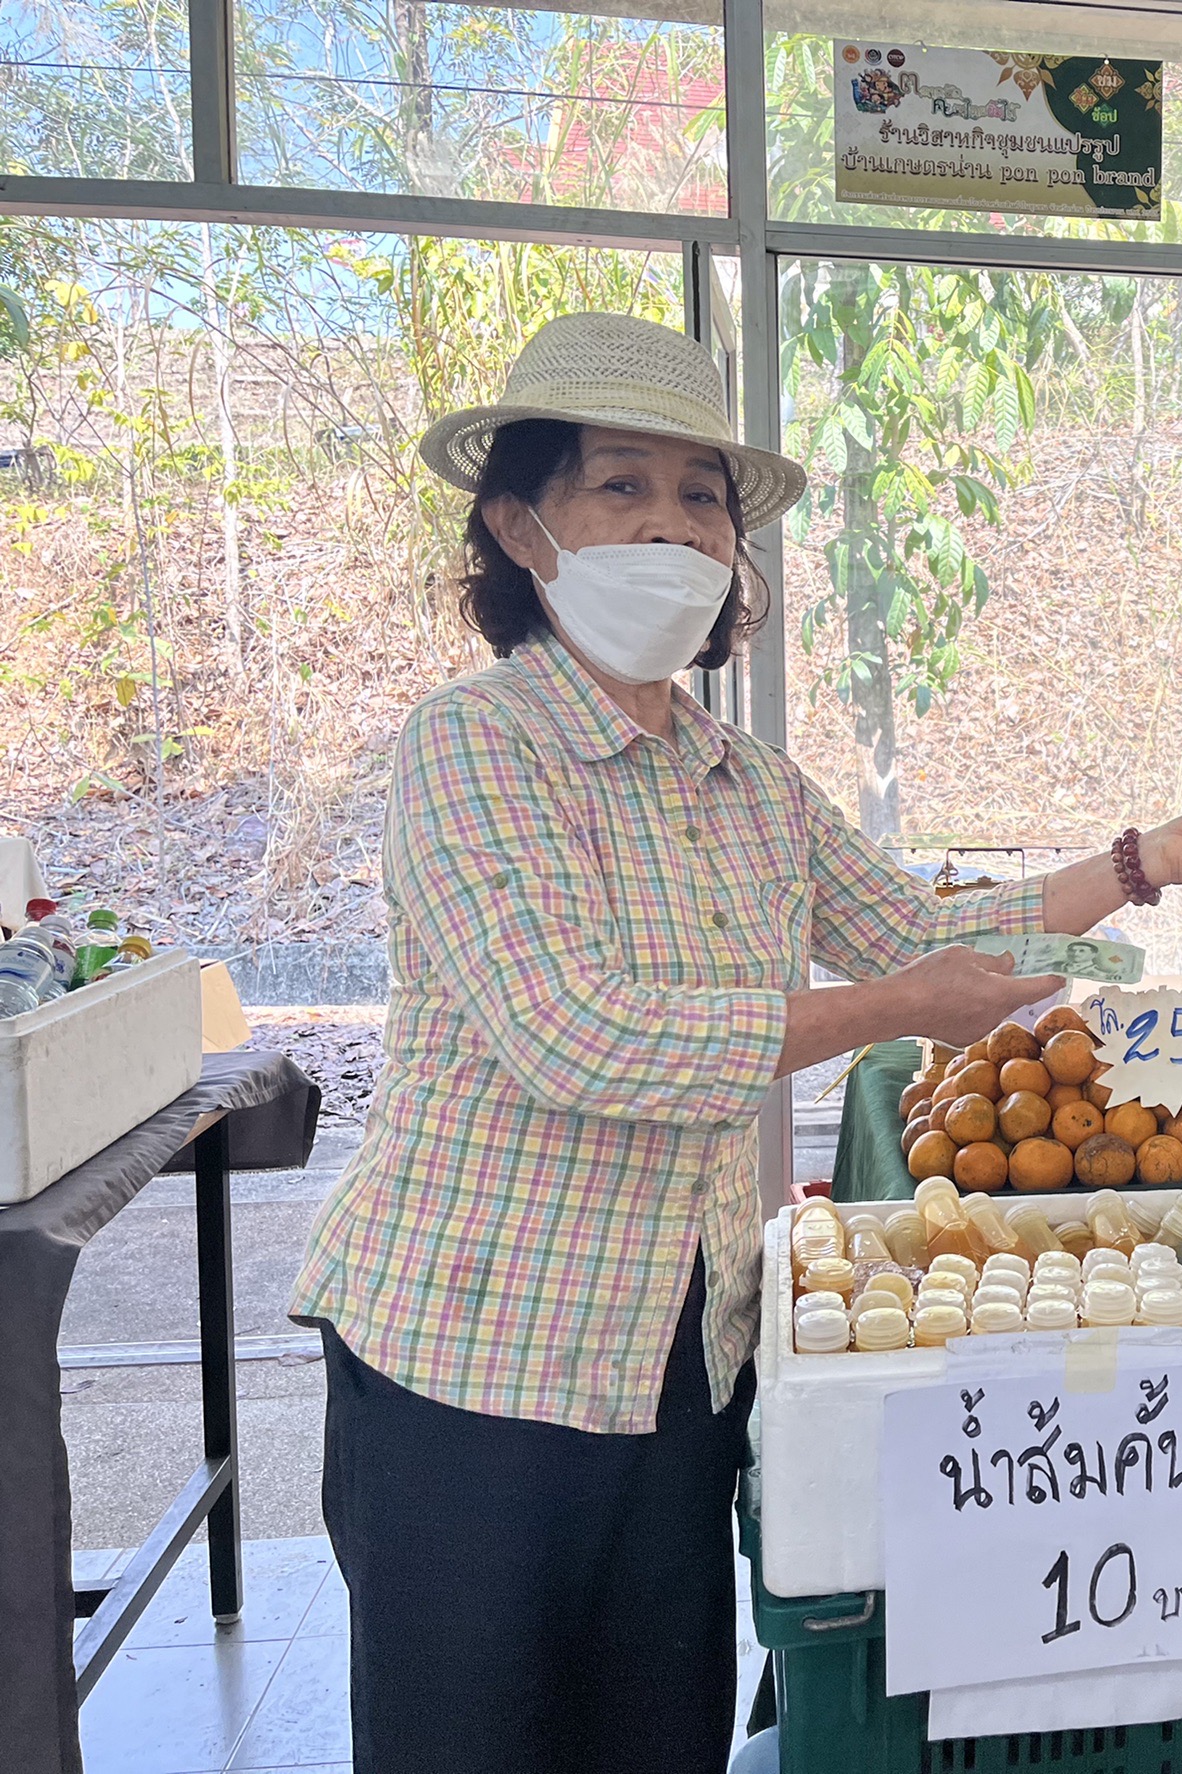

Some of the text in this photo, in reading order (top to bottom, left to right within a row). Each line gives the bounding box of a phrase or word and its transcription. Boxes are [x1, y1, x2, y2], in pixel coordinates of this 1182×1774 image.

[1000, 166, 1038, 185] pon
[1047, 168, 1086, 188] pon
[1093, 165, 1156, 187] brand
[1041, 1542, 1137, 1644] 10
